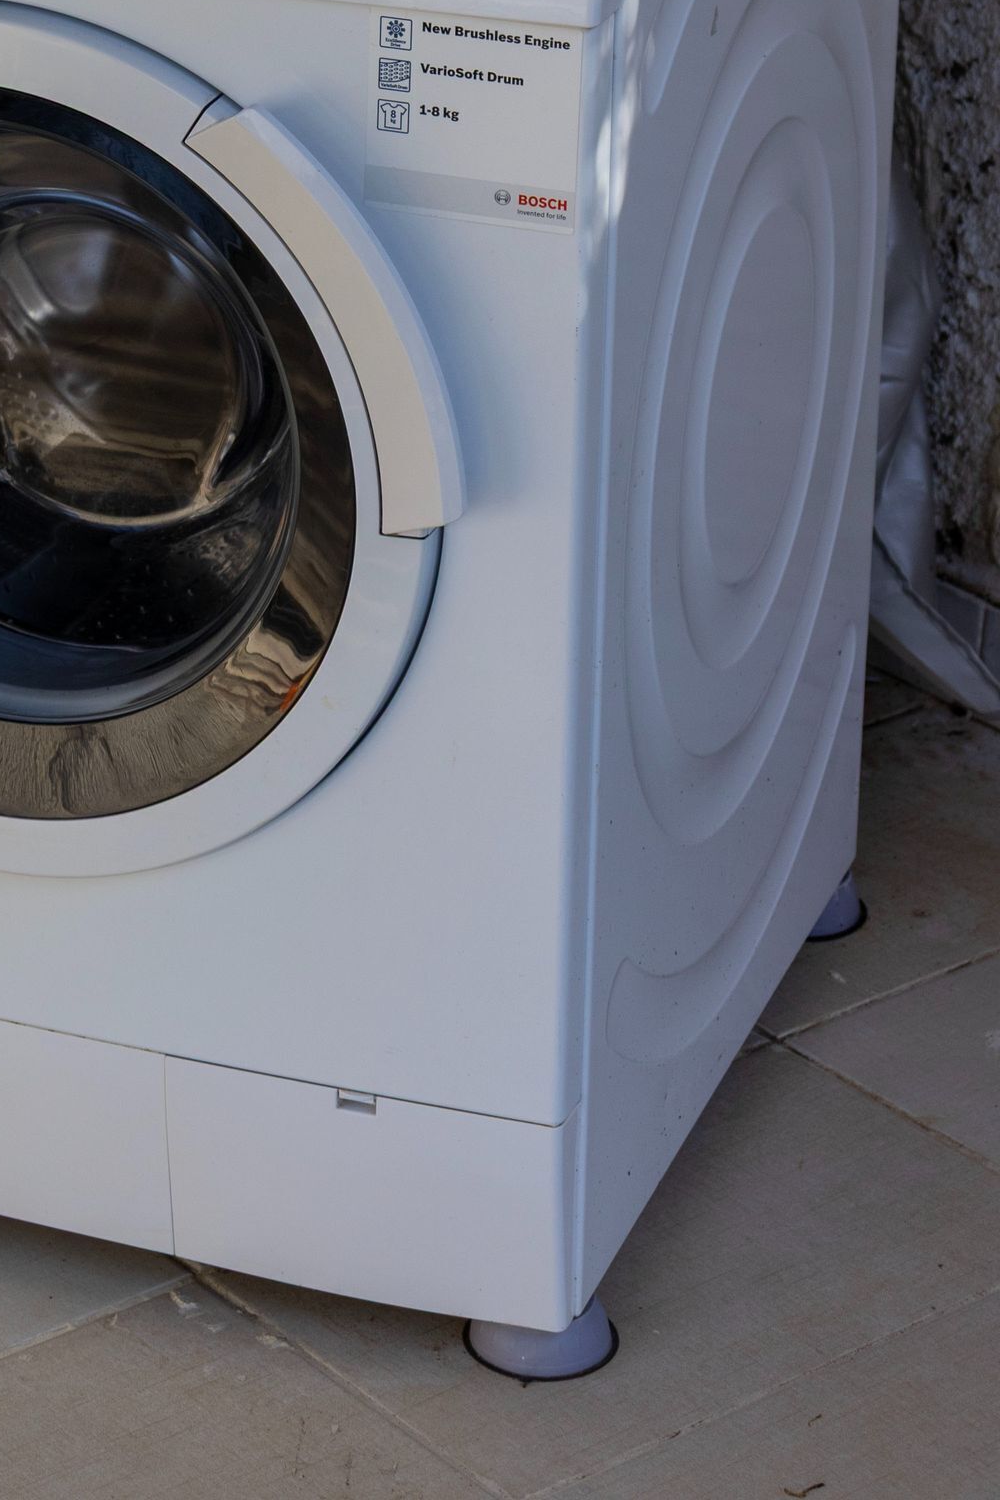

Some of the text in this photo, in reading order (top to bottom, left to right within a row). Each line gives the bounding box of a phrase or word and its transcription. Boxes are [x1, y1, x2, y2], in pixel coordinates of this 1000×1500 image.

[422, 22, 571, 50] New Brushless Engine
[420, 63, 524, 86] VarioSoft Drum
[391, 109, 396, 119] 8
[419, 105, 459, 122] 1-8 kg
[518, 194, 568, 211] BOSCH
[516, 208, 567, 221] Invented for life
